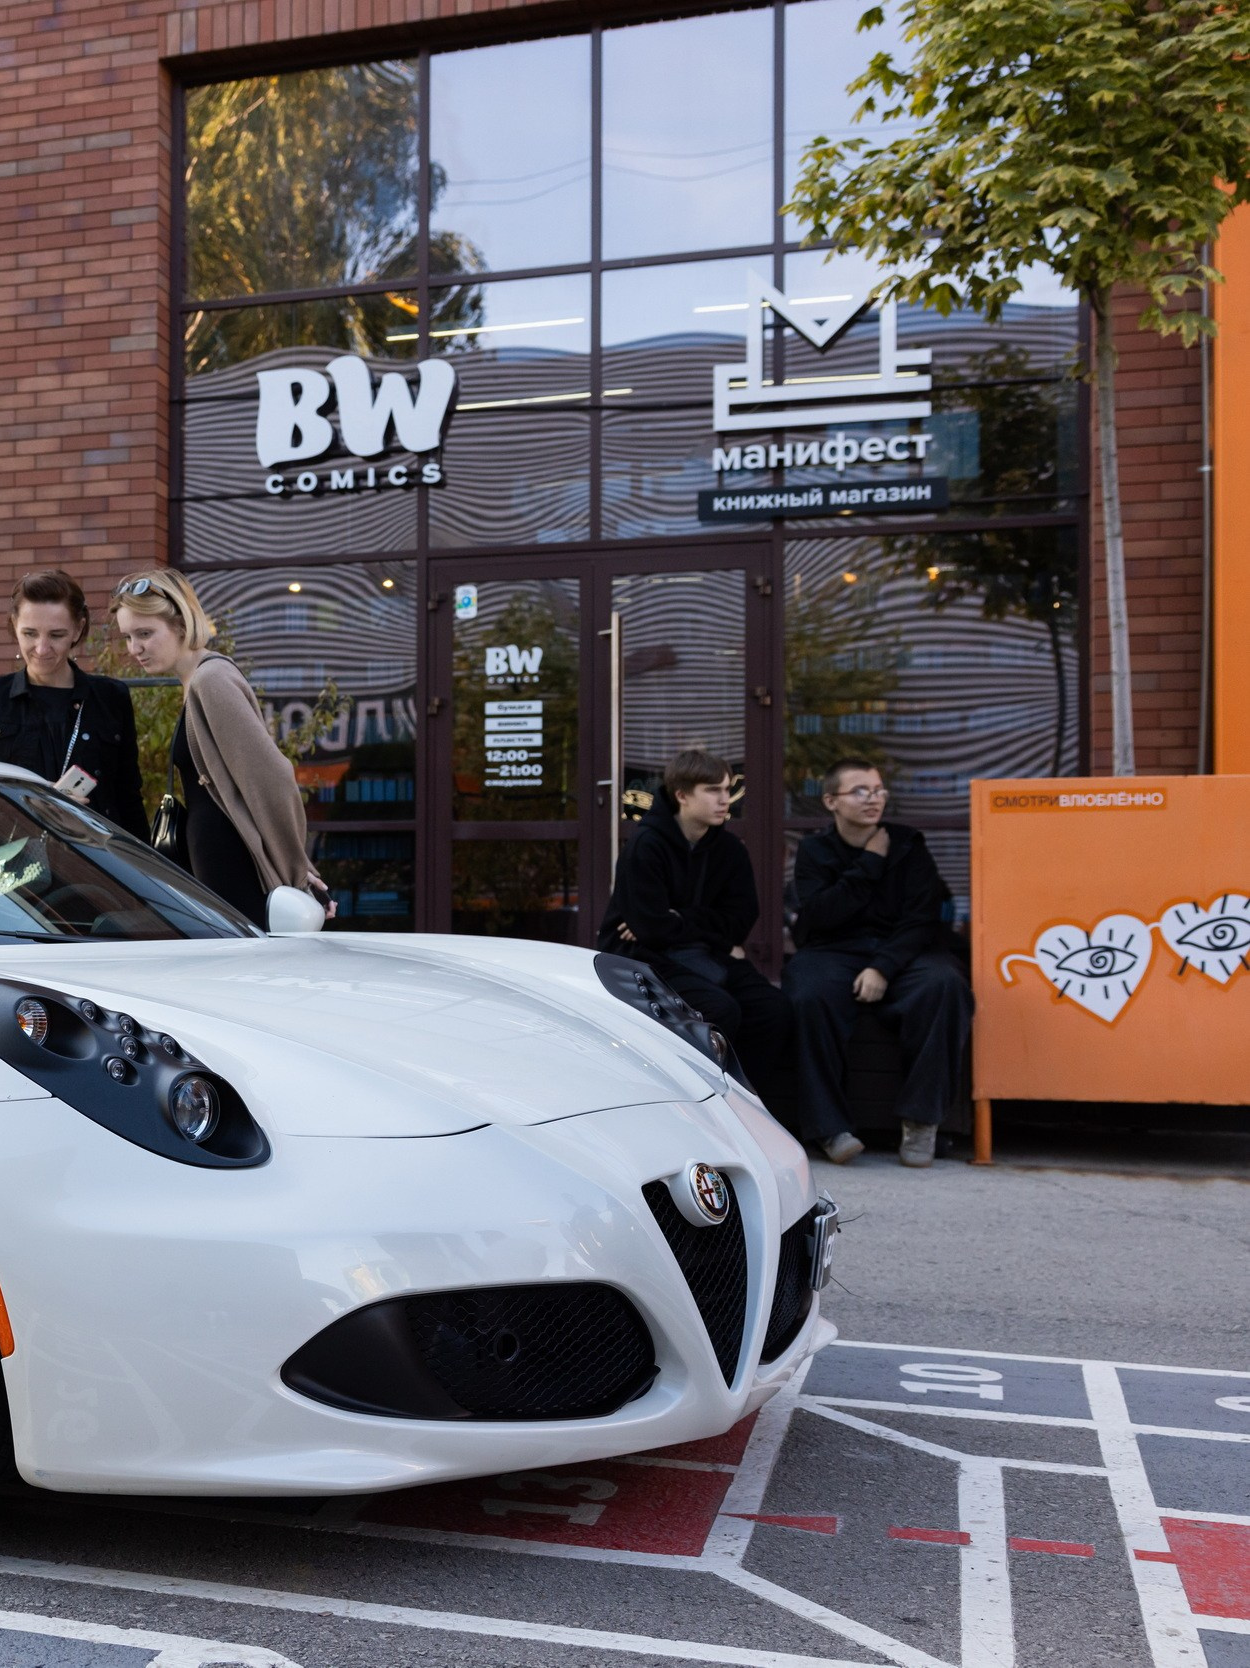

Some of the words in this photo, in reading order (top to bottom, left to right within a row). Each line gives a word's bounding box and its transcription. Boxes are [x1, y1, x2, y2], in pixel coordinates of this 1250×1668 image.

[256, 355, 456, 468] BW
[713, 432, 932, 472] манифест
[265, 463, 442, 495] COMICS
[485, 644, 543, 676] BW
[899, 1363, 1004, 1400] 10
[479, 1472, 619, 1526] 13
